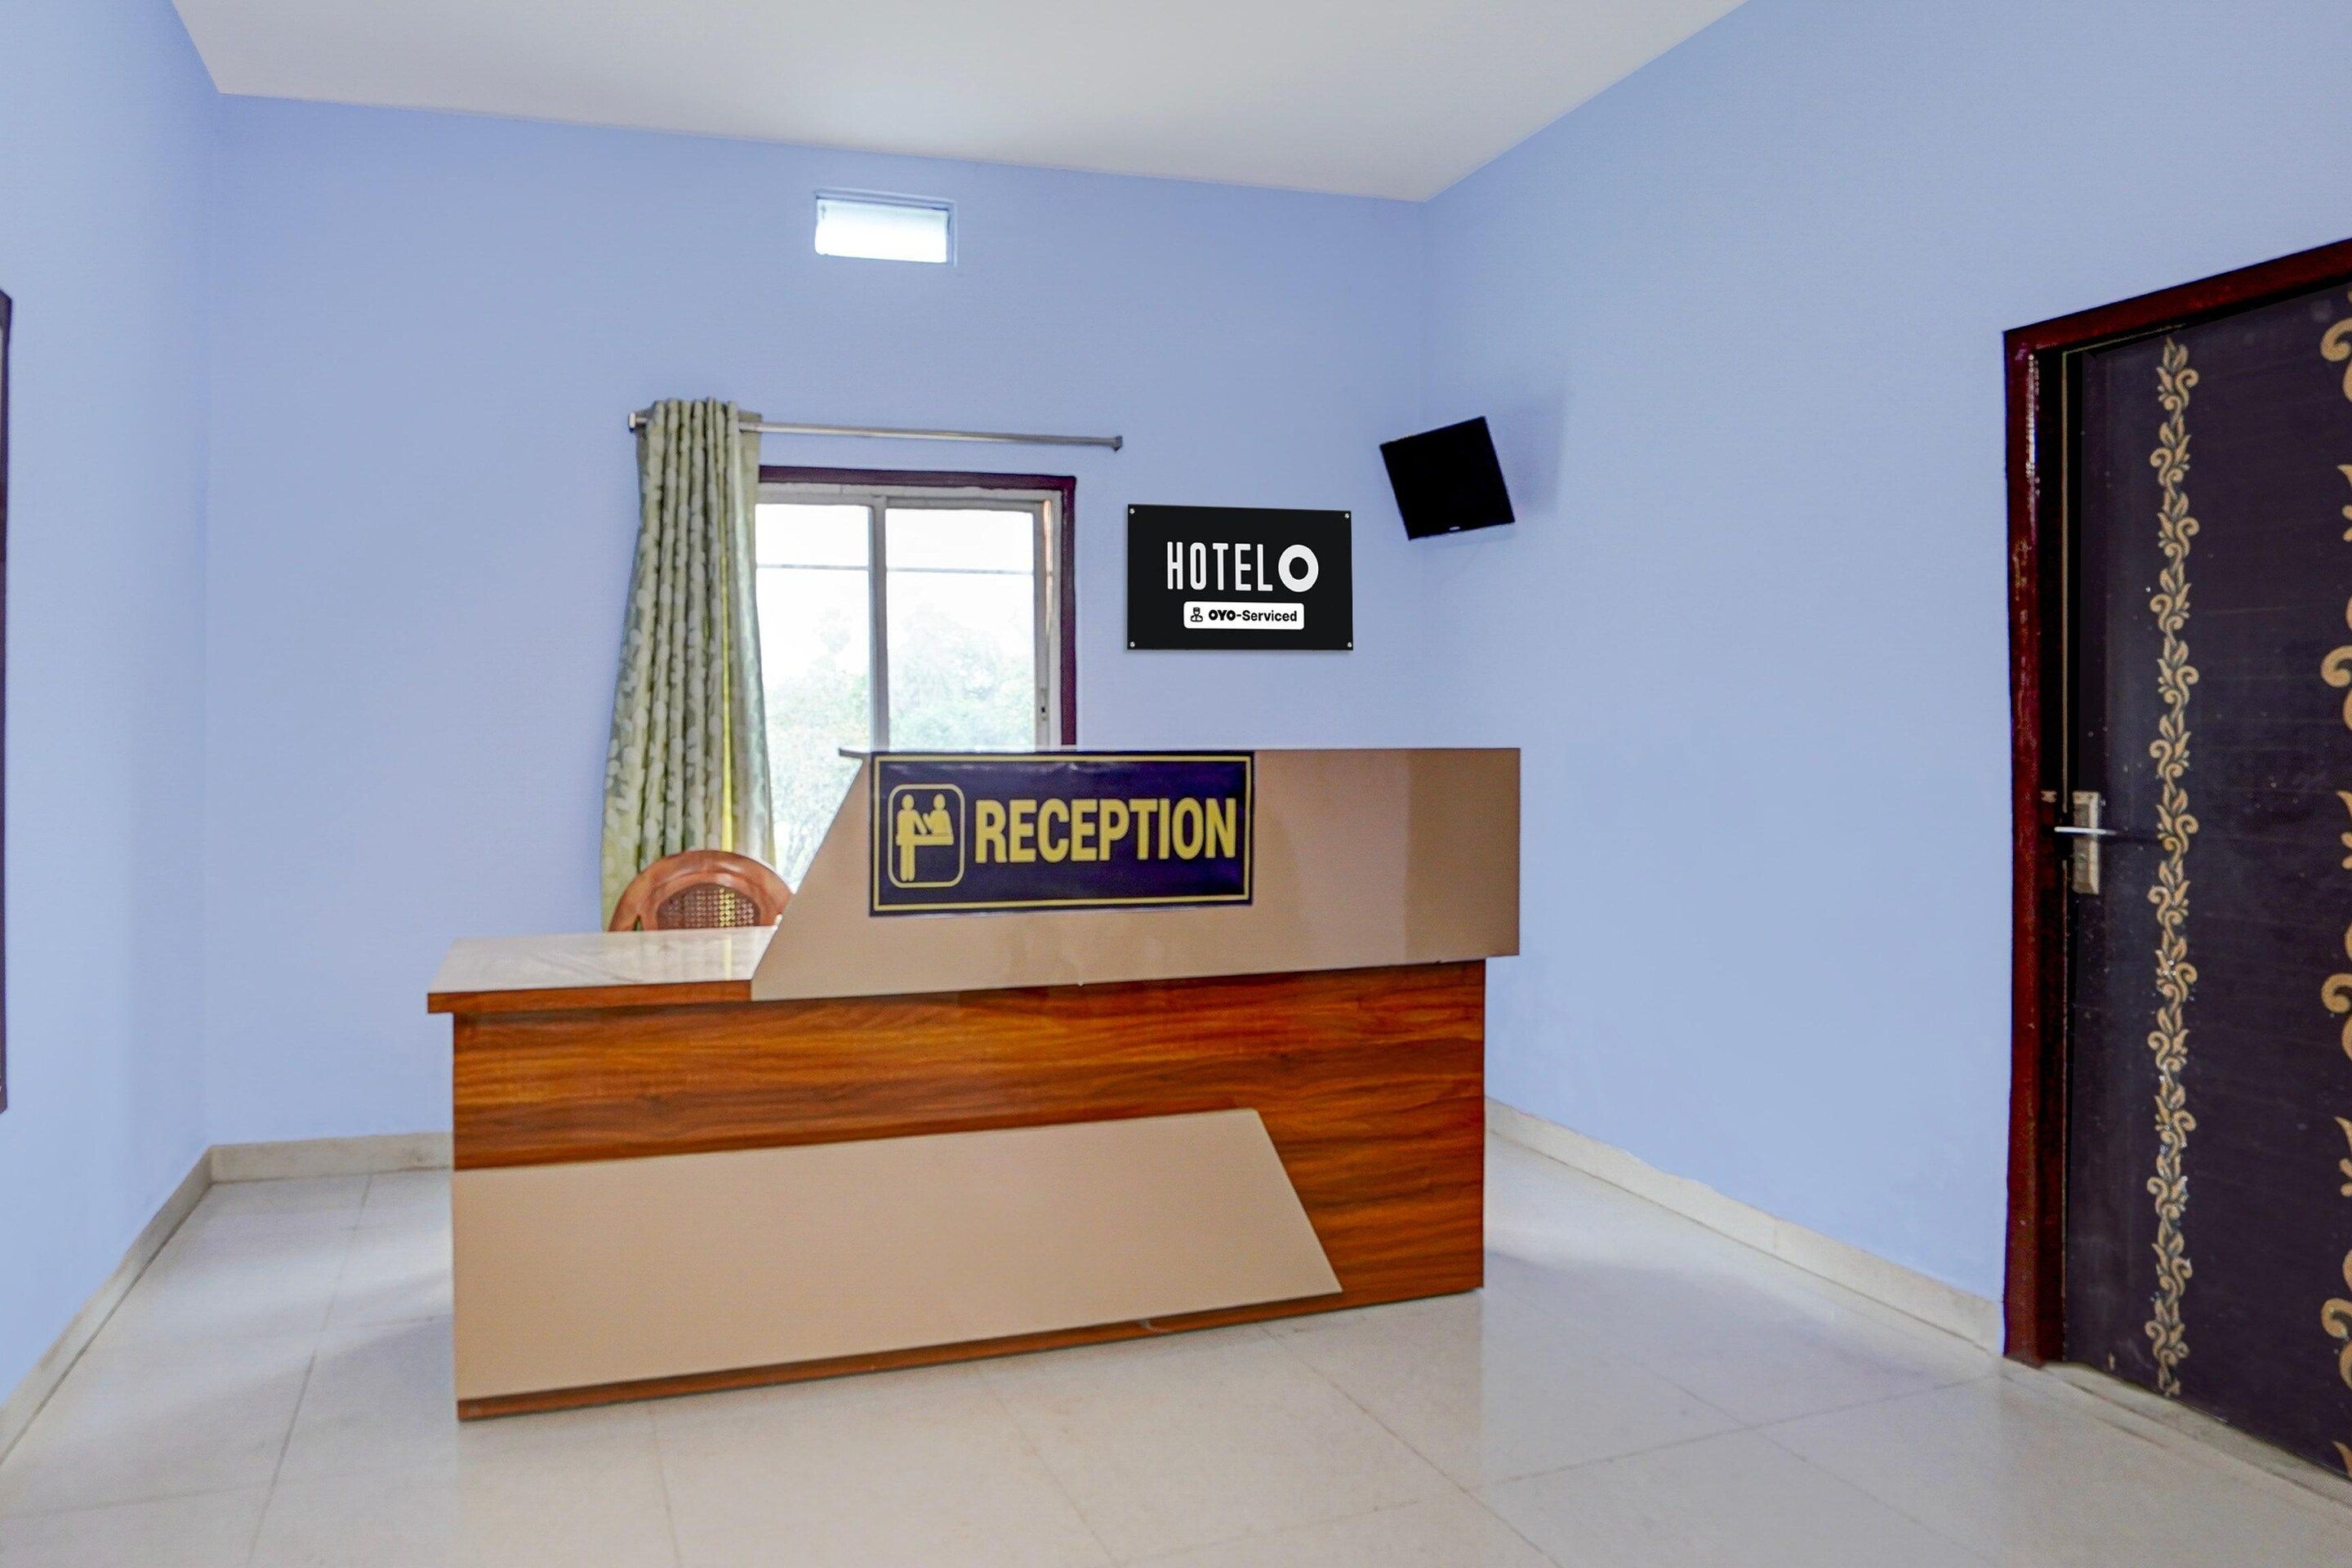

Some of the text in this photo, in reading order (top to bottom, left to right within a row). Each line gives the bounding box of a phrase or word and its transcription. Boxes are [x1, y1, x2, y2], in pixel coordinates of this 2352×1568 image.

[1167, 541, 1319, 592] HOTEL O
[1208, 609, 1297, 622] OYO-Serviced
[975, 797, 1236, 863] RECEPTION
